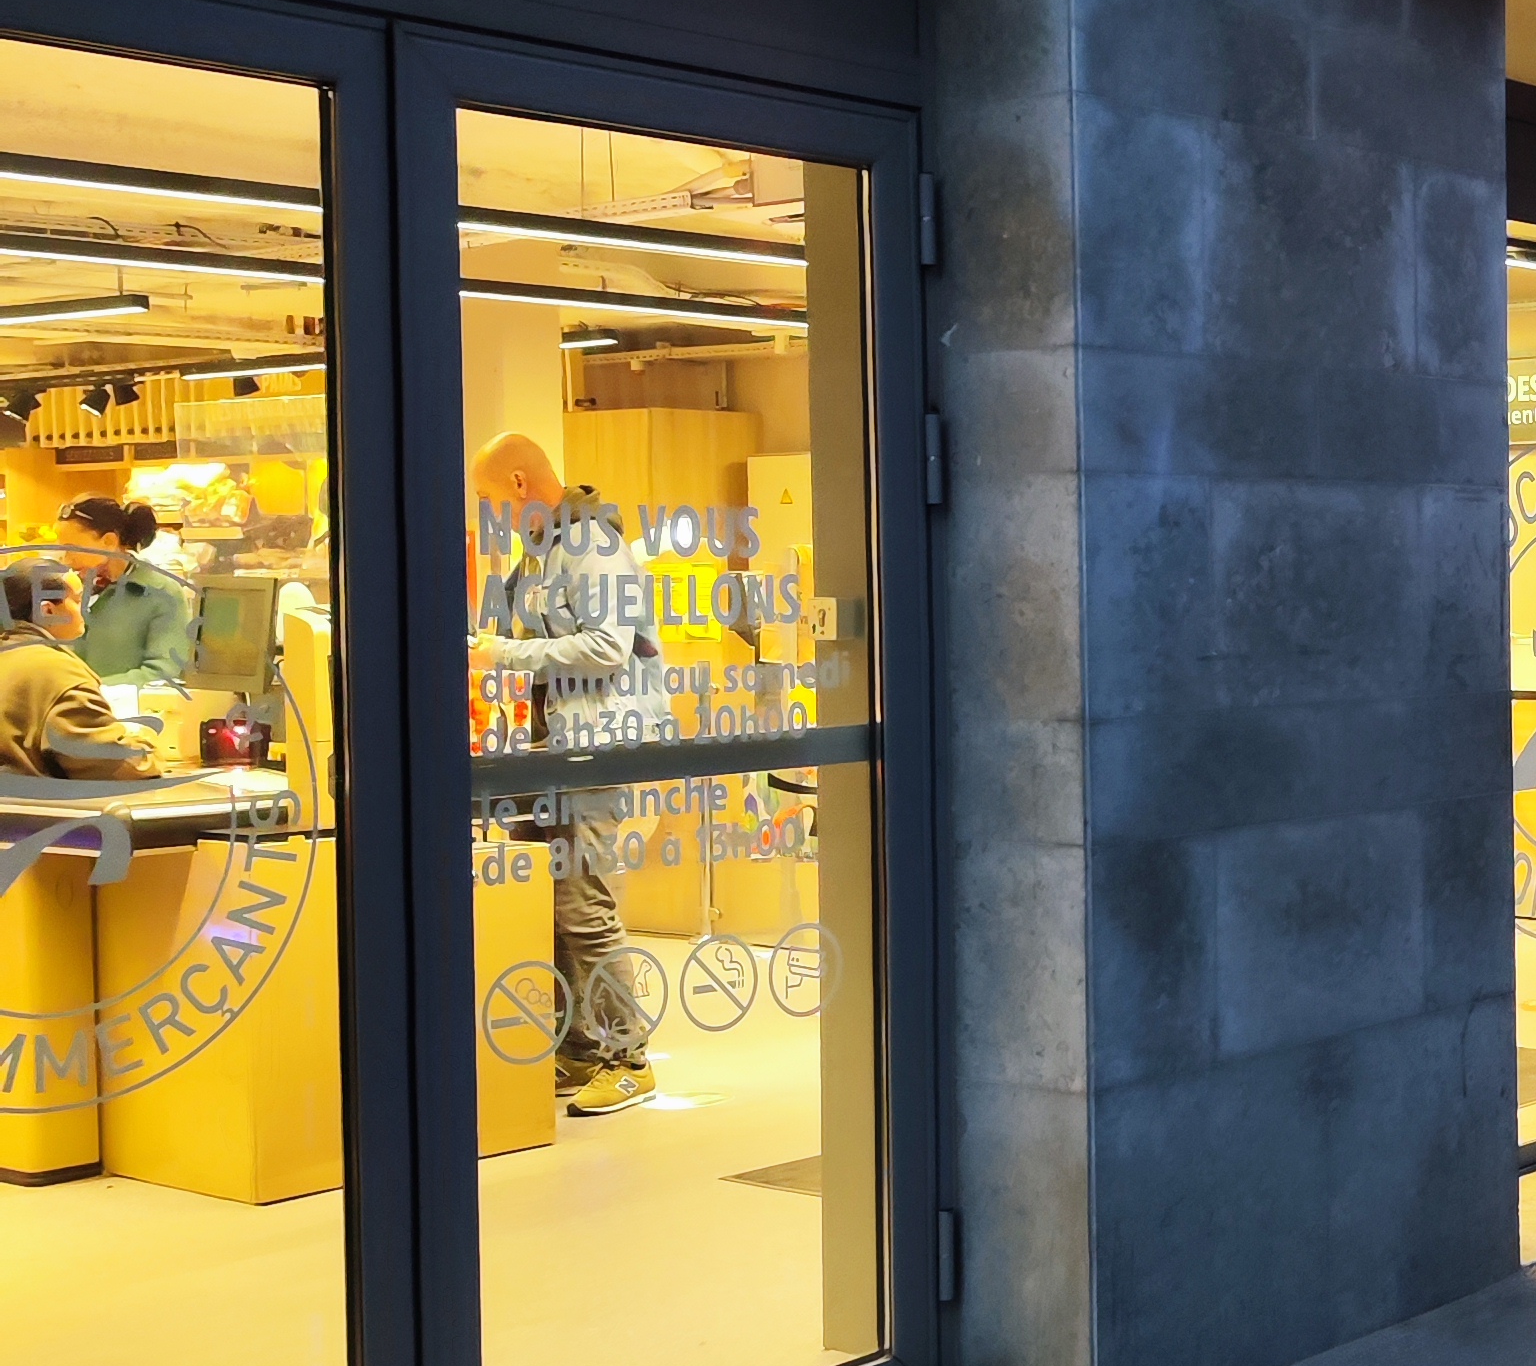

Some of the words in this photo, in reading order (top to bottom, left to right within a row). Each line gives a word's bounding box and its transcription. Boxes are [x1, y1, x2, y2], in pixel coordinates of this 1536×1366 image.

[478, 500, 620, 557] NOUS
[637, 504, 761, 557] VOUS
[478, 573, 801, 629] ACCUEILLONS
[480, 663, 531, 703] du
[664, 664, 711, 695] au
[480, 720, 531, 758] de
[547, 710, 644, 754] 8h30
[694, 701, 808, 745] 20h00
[481, 787, 520, 831] le
[481, 843, 533, 886] de
[548, 830, 646, 880] 8h30
